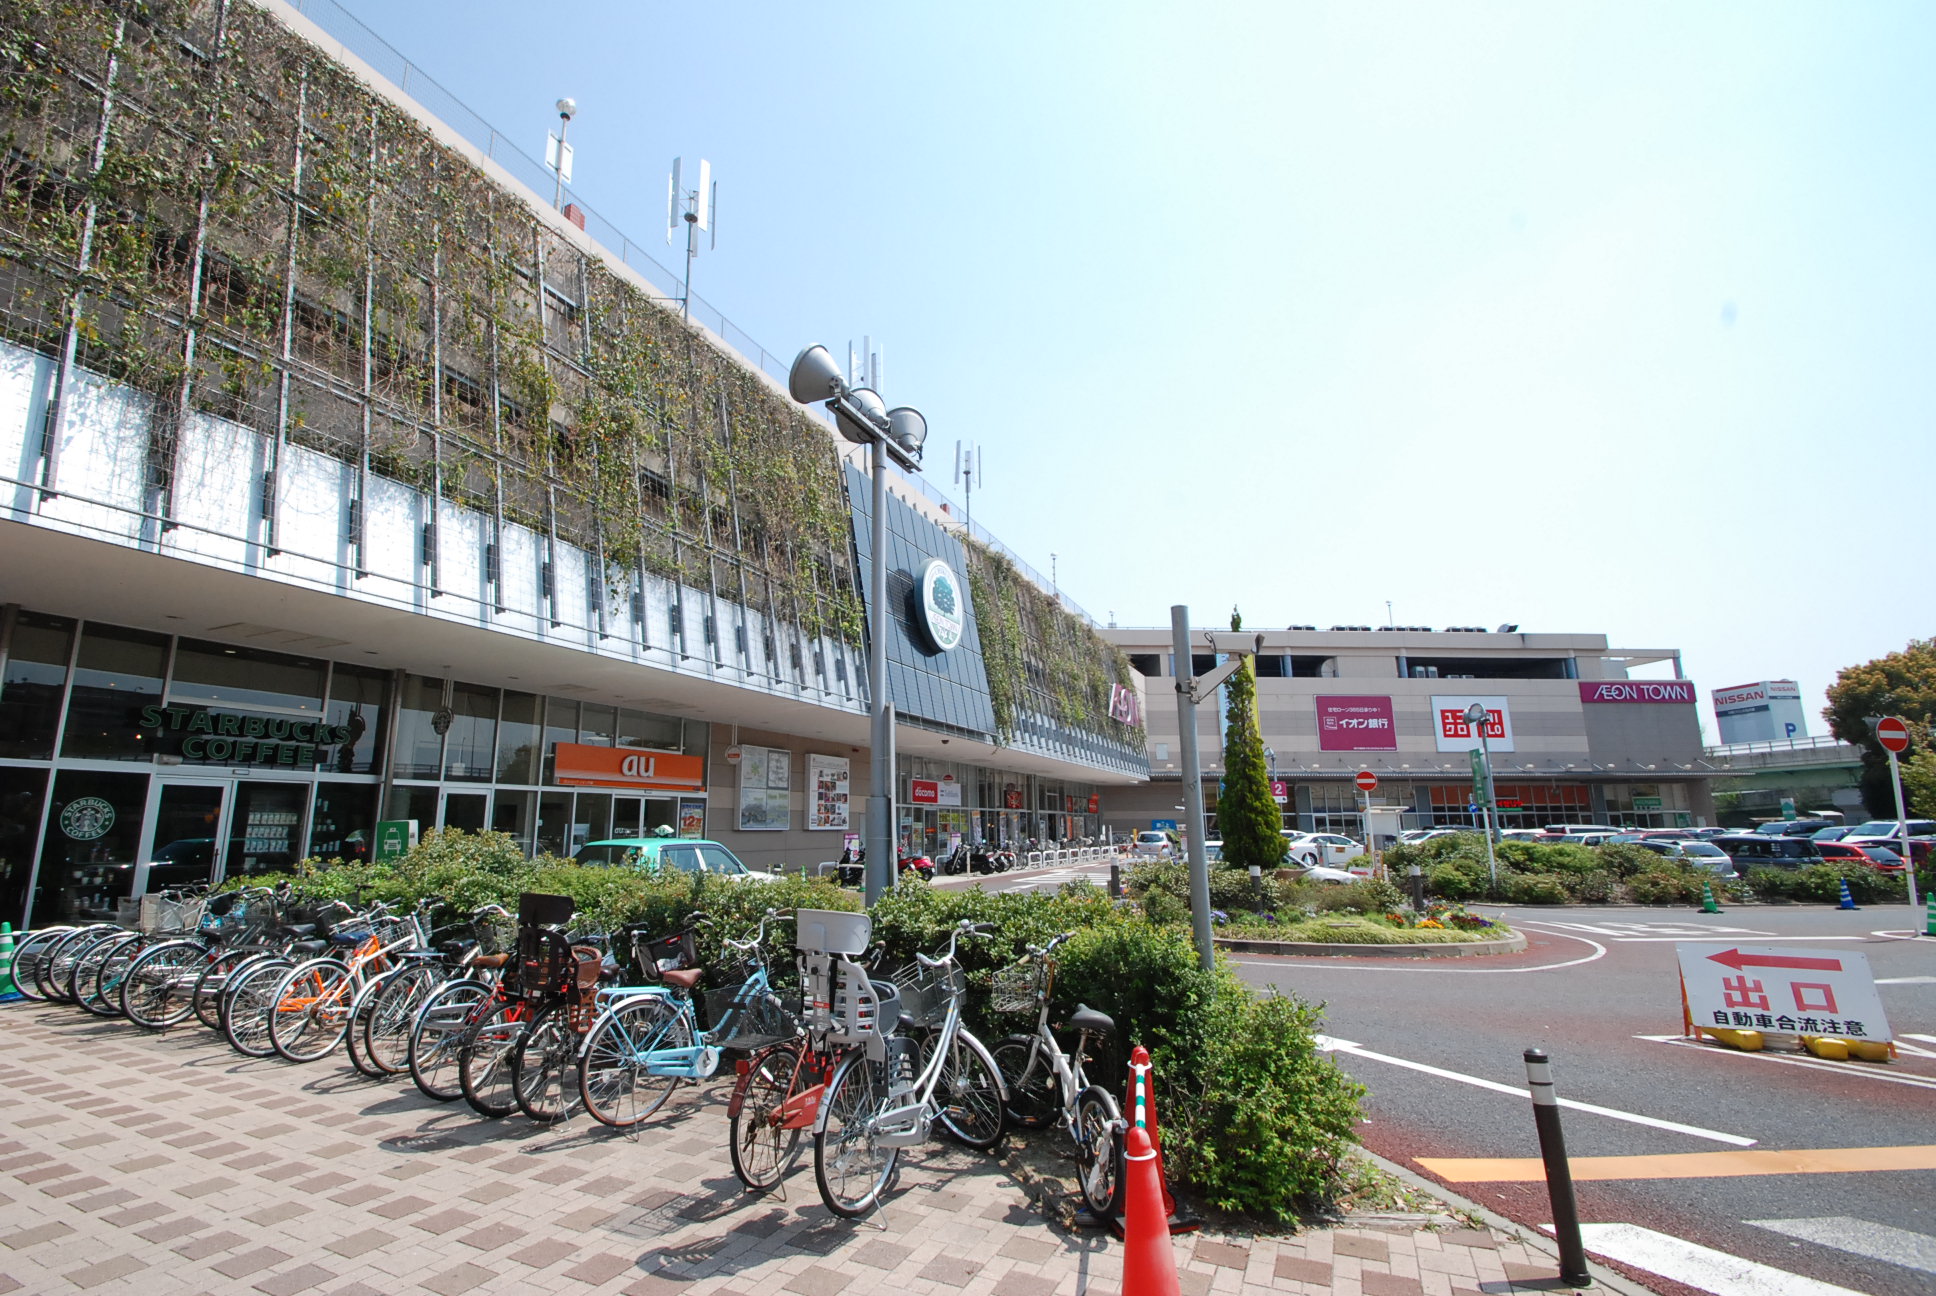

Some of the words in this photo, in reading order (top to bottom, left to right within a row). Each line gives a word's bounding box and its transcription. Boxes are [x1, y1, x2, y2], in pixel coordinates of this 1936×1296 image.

[1640, 684, 1689, 700] TOWN
[1714, 690, 1765, 705] NISSAN
[139, 704, 353, 745] STARBUCKS
[1339, 718, 1389, 729] イオン銀行
[1445, 724, 1468, 735] クロ
[1785, 722, 1797, 738] P
[182, 735, 317, 766] COFFEE
[621, 754, 656, 778] au
[914, 786, 935, 797] docomo
[1274, 783, 1283, 795] 2
[64, 799, 113, 819] STARBUCKS
[65, 826, 105, 838] COFFEE
[1721, 975, 1840, 1015] 出口
[1712, 1009, 1868, 1037] 自動車合流注意
